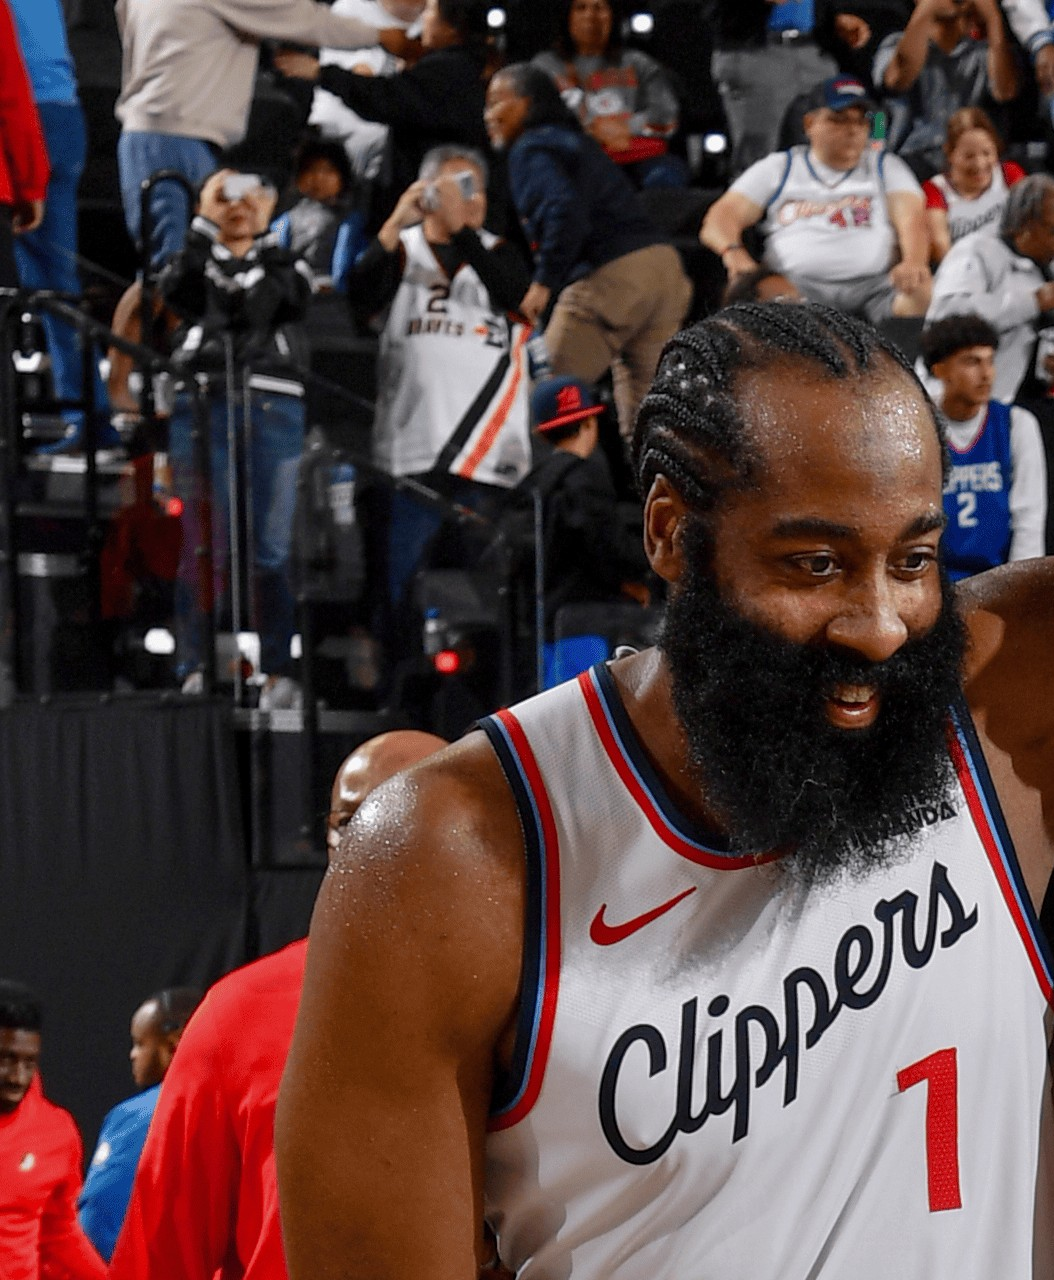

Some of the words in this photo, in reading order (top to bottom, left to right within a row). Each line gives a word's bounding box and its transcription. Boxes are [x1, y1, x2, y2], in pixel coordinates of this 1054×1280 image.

[943, 461, 1003, 495] PPERS
[957, 492, 979, 528] 2
[599, 860, 979, 1166] Clippers
[896, 1047, 963, 1213] 1
